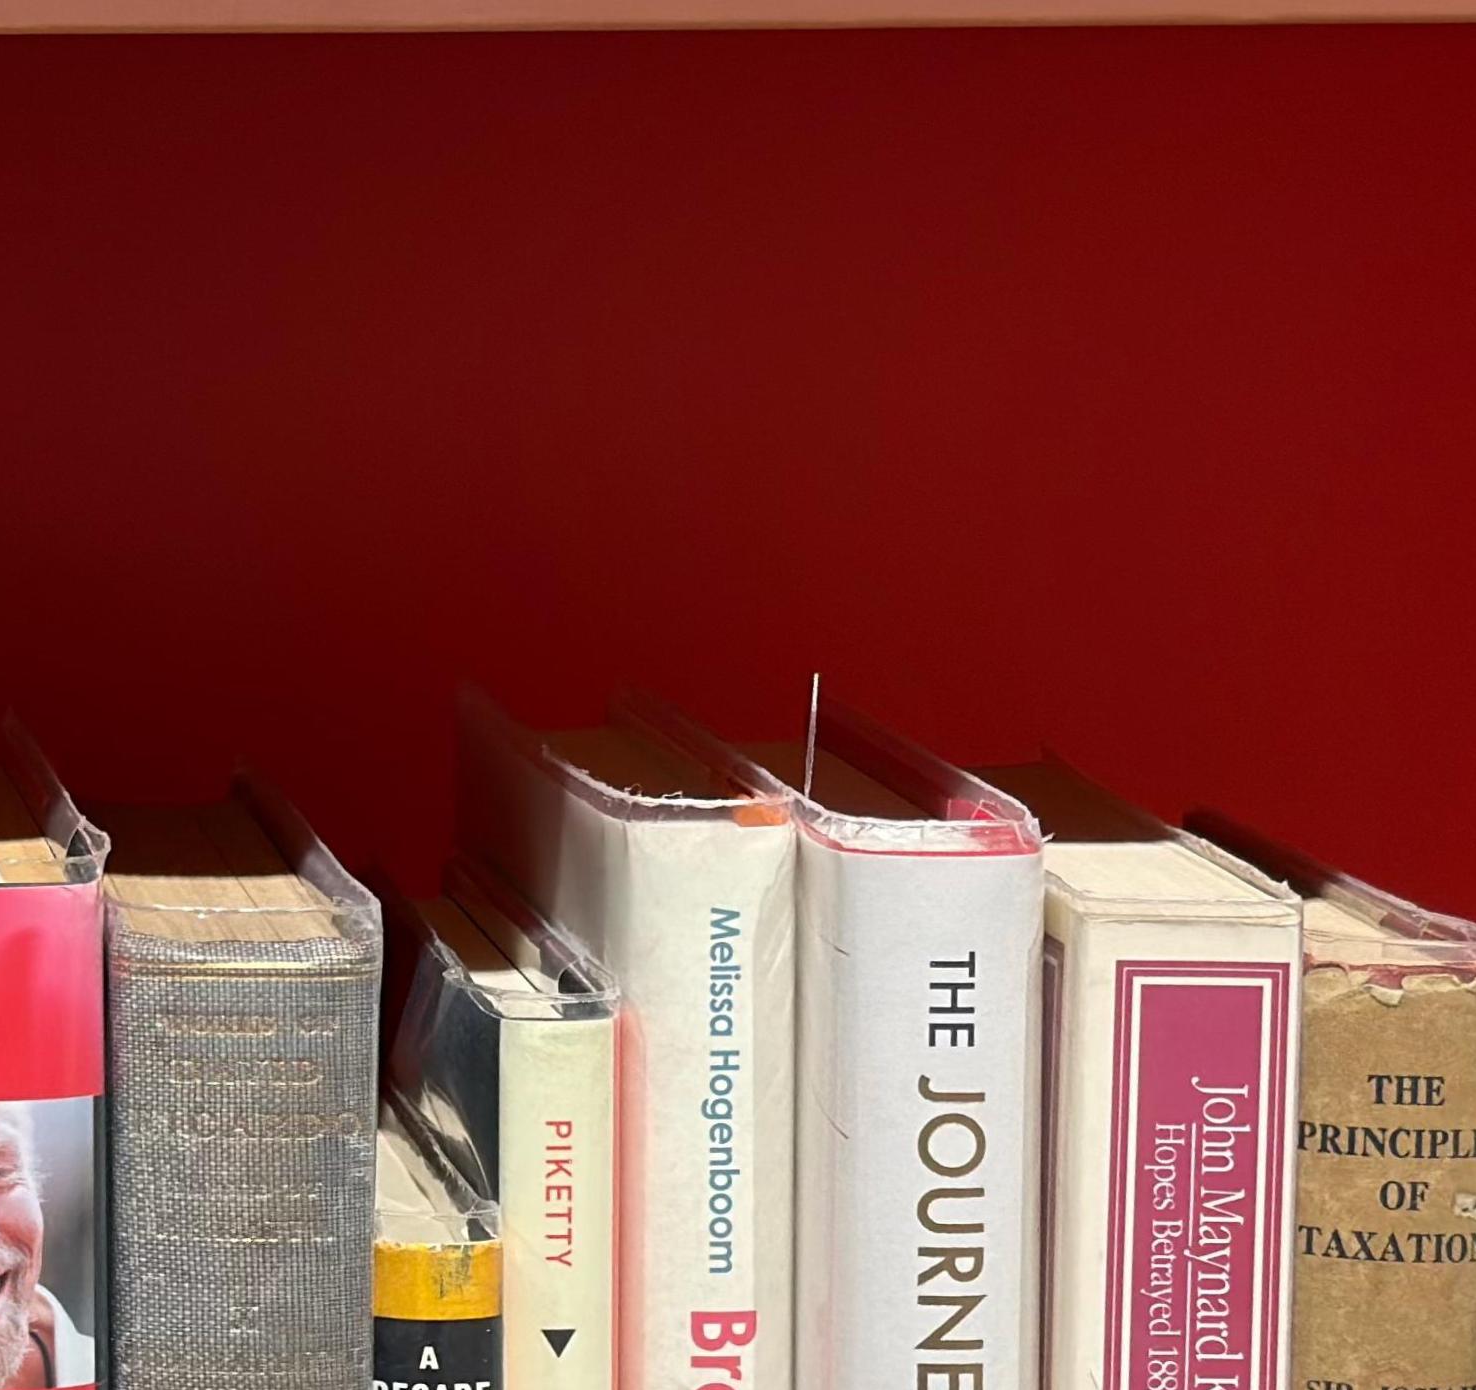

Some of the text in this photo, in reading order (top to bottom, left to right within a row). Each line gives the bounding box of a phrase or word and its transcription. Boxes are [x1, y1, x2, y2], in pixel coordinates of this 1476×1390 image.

[928, 951, 976, 1048] THE
[701, 907, 742, 1275] Melissa Hogenboom
[1191, 1076, 1251, 1174] John
[1367, 1075, 1445, 1107] THE
[545, 1120, 572, 1267] PIKETTY
[1144, 1121, 1185, 1211] Hopes
[1380, 1181, 1429, 1211] OF
[1139, 1220, 1183, 1336] Betrayed
[1183, 1189, 1245, 1362] Maynard
[419, 1347, 439, 1370] A
